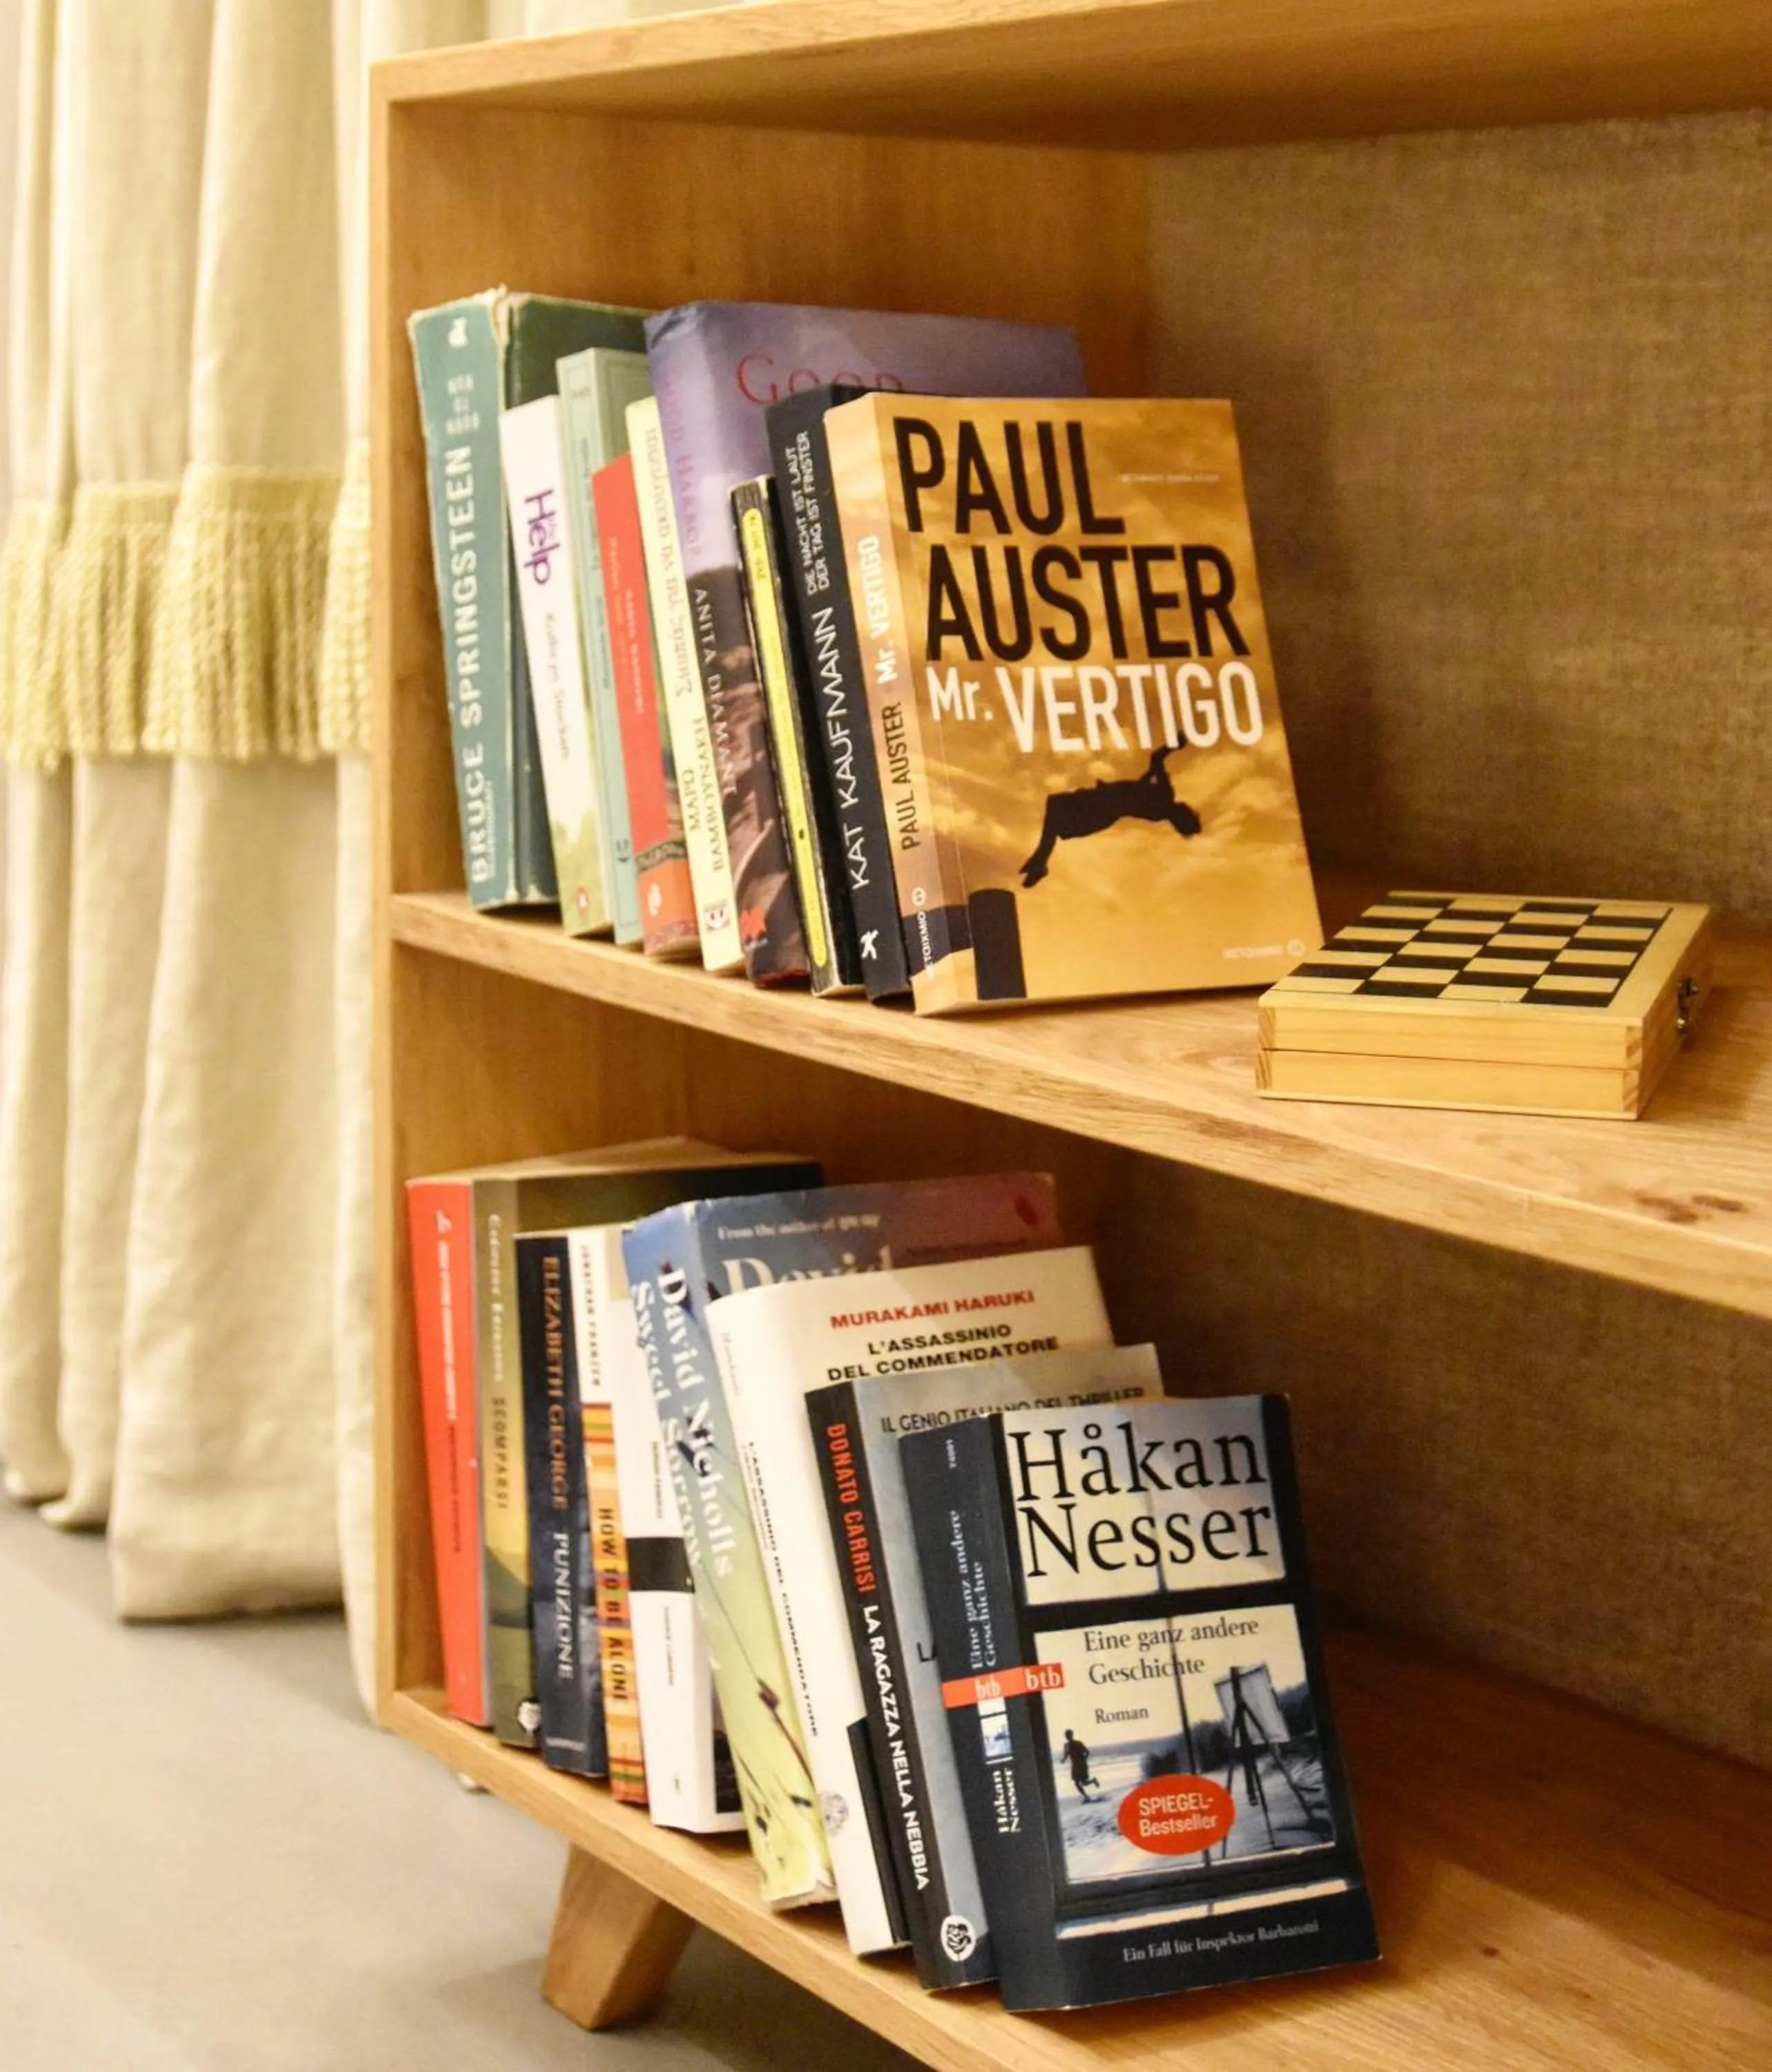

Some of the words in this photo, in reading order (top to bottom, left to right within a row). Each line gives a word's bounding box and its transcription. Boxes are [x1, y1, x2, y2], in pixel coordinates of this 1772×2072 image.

[784, 448, 801, 485] LAUT
[796, 431, 815, 495] FINSTER
[893, 417, 1126, 535] PAUL
[791, 490, 805, 512] IST
[805, 498, 820, 521] IST
[523, 488, 561, 586] Help
[796, 517, 813, 568] NACHT
[810, 522, 825, 555] TAG
[445, 446, 483, 729] SPRINGSTEEN
[805, 568, 818, 596] DIE
[816, 557, 830, 591] DER
[857, 535, 892, 640] VERTIGO
[926, 544, 1251, 662] AUSTER
[693, 588, 715, 664] ANITA
[706, 672, 738, 797] DIAMANT
[875, 640, 898, 684] Mr.
[811, 607, 859, 810] KAUFMANN
[926, 666, 993, 720] Mr.
[995, 662, 1264, 752] VERTIGO
[881, 701, 912, 786] AUSTER
[463, 742, 492, 884] BRUCE
[894, 789, 921, 852] PAUL
[843, 823, 870, 890] KAT
[542, 1256, 565, 1398] ELIZABETH
[830, 1301, 950, 1329] MURAKAMI
[953, 1289, 1035, 1312] HARUKI
[867, 1325, 1012, 1356] L'ASSASSINIO
[827, 1365, 870, 1382] DEL
[876, 1336, 1060, 1375] COMMENDATORE
[492, 1397, 510, 1509] SCOMPARSI
[630, 1280, 673, 1403] Sweet
[659, 1417, 703, 1569] Sorrow
[657, 1268, 704, 1391] David
[683, 1397, 735, 1579] Nicholls
[880, 1417, 896, 1433] IL
[899, 1410, 951, 1432] GENIO
[548, 1404, 568, 1511] GEORGE
[827, 1423, 860, 1504] DONATO
[1008, 1421, 1267, 1502] Håkan
[599, 1508, 617, 1556] HOW
[843, 1510, 876, 1593] CARRISI
[950, 1510, 968, 1574] andere
[1017, 1504, 1271, 1577] Nesser
[552, 1531, 574, 1681] PUNIZIONE
[602, 1565, 618, 1591] TO
[961, 1579, 979, 1622] ganz
[604, 1600, 621, 1629] BE
[863, 1605, 880, 1634] LA
[974, 1562, 996, 1667] Geschichte
[1083, 1630, 1131, 1652] Eine
[1137, 1628, 1185, 1652] ganz
[1191, 1618, 1260, 1642] andere
[606, 1636, 628, 1703] ALONE
[970, 1627, 983, 1669] Eine
[1024, 1669, 1062, 1690] btb
[1089, 1658, 1205, 1685] Geschichte
[869, 1636, 898, 1738] RAGAZZA
[974, 1678, 1001, 1698] btb
[1095, 1706, 1149, 1725] Roman
[889, 1740, 921, 1810] NELLA
[1004, 1768, 1021, 1834] Nesser
[1139, 1793, 1215, 1816] SPIEGEL-
[903, 1811, 930, 1892] NEBBIA
[1139, 1813, 1218, 1838] Bestseller
[1123, 1946, 1145, 1962] Ein
[1148, 1939, 1172, 1958] Fall
[1196, 1932, 1255, 1952] Inspektor
